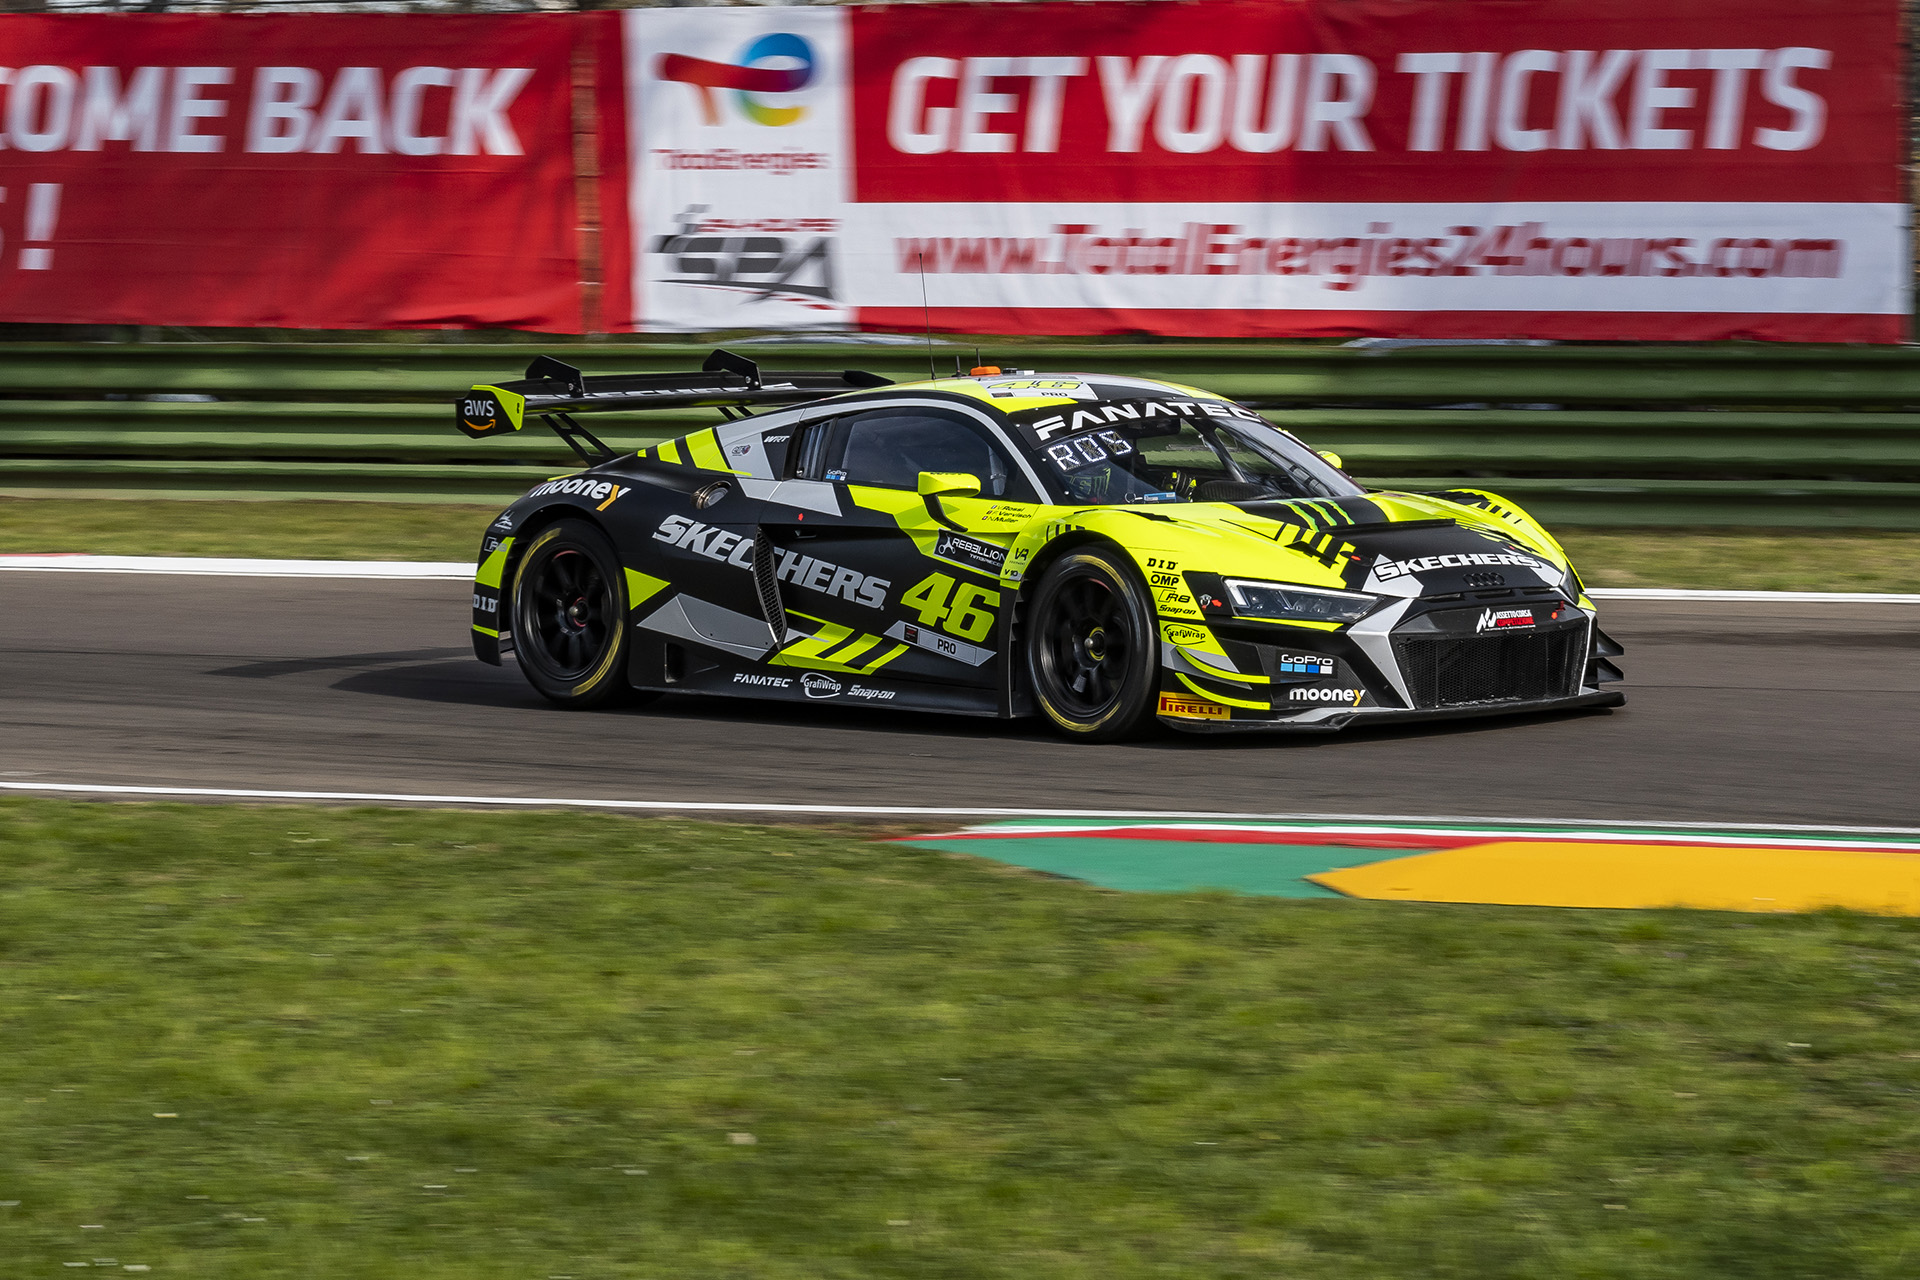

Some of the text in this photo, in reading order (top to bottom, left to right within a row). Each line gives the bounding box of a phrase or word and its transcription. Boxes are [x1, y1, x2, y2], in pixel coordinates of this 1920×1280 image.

[888, 47, 1832, 154] GET YOUR TICKETS
[0, 65, 537, 156] OME BACK
[895, 221, 1847, 291] www.TotalEnergies24hours.com
[464, 399, 495, 417] aws
[1032, 402, 1261, 441] FANATEC
[763, 435, 791, 443] WRT
[1047, 430, 1132, 471] ROS
[827, 468, 848, 476] GoPro
[529, 478, 631, 512] mooney
[652, 514, 891, 610] SKECHERS
[1147, 557, 1178, 571] DID
[1375, 553, 1541, 581] SKECHERS
[1150, 574, 1180, 587] OMP
[472, 593, 498, 613] DID
[901, 571, 1000, 643] 46
[1158, 604, 1197, 616] Snap-on
[1166, 628, 1206, 640] GrafiWrap
[937, 638, 957, 655] PRO
[1281, 654, 1334, 666] GoPro
[733, 673, 793, 688] FANATEC
[803, 678, 841, 692] GrafiWrap
[847, 684, 896, 700] Snap-on
[1289, 688, 1366, 707] mooney
[1160, 696, 1223, 715] PIRELLI
